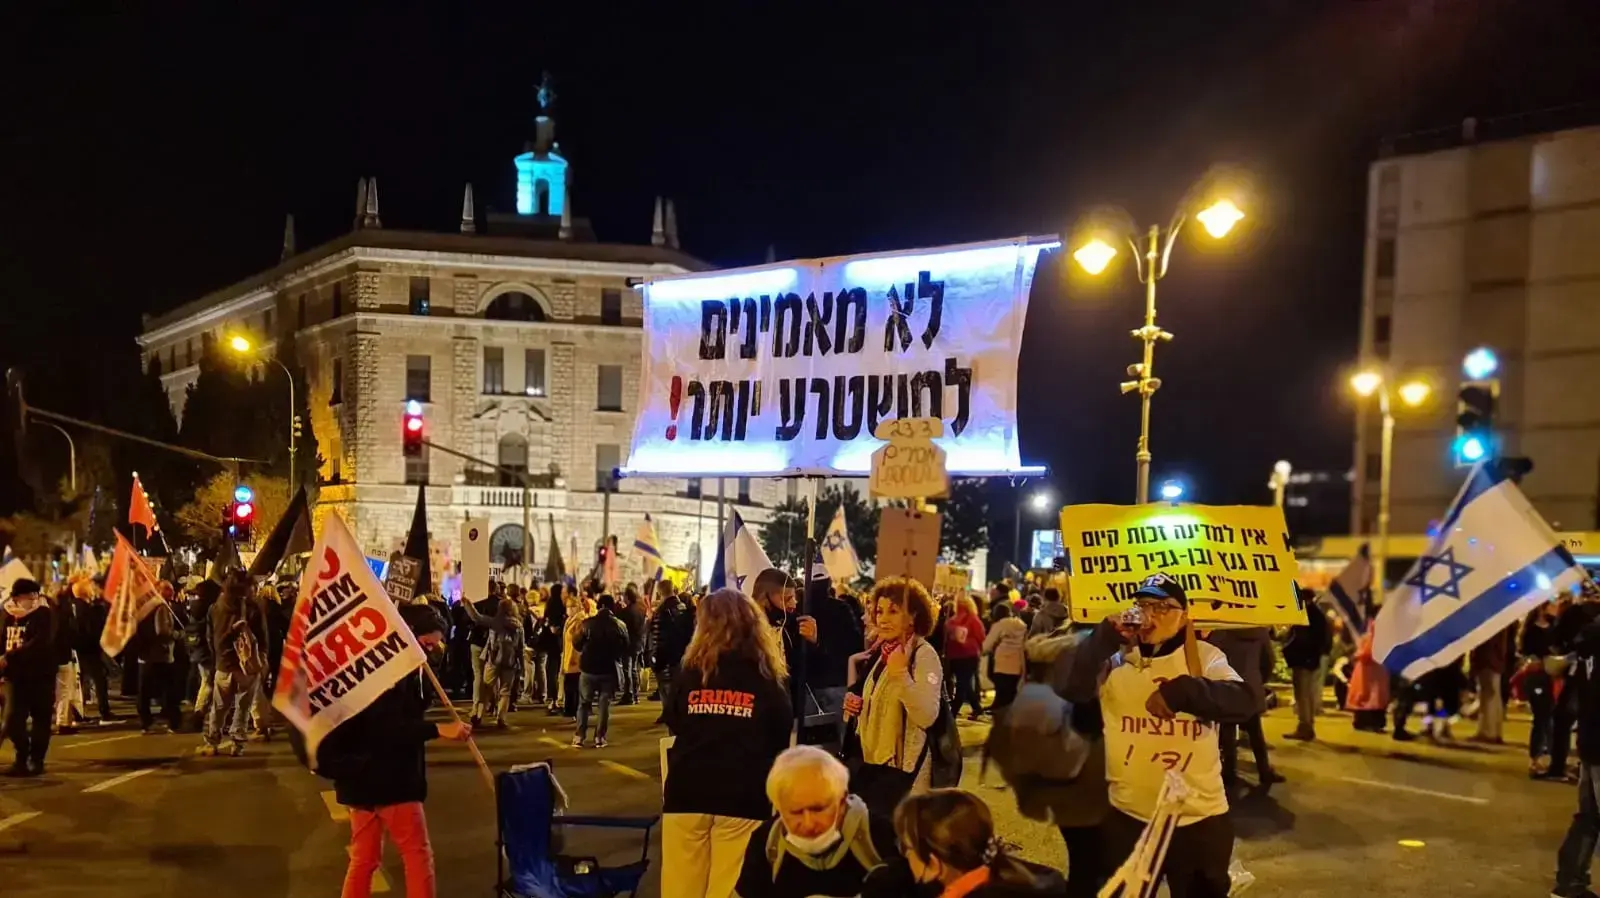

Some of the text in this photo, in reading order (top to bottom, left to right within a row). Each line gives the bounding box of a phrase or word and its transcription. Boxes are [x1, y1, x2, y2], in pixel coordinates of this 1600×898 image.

[699, 270, 944, 360] לא מאמינים
[665, 375, 762, 441] יותר!
[1081, 524, 1269, 548] אין למדינה זכות קיום
[1080, 547, 1280, 574] בה גנץ ובן-גביר בפנים
[1089, 580, 1142, 603] חוץ...
[687, 689, 755, 707] CRIME
[687, 703, 752, 718] MINISTER
[1121, 715, 1203, 741] קדנציות
